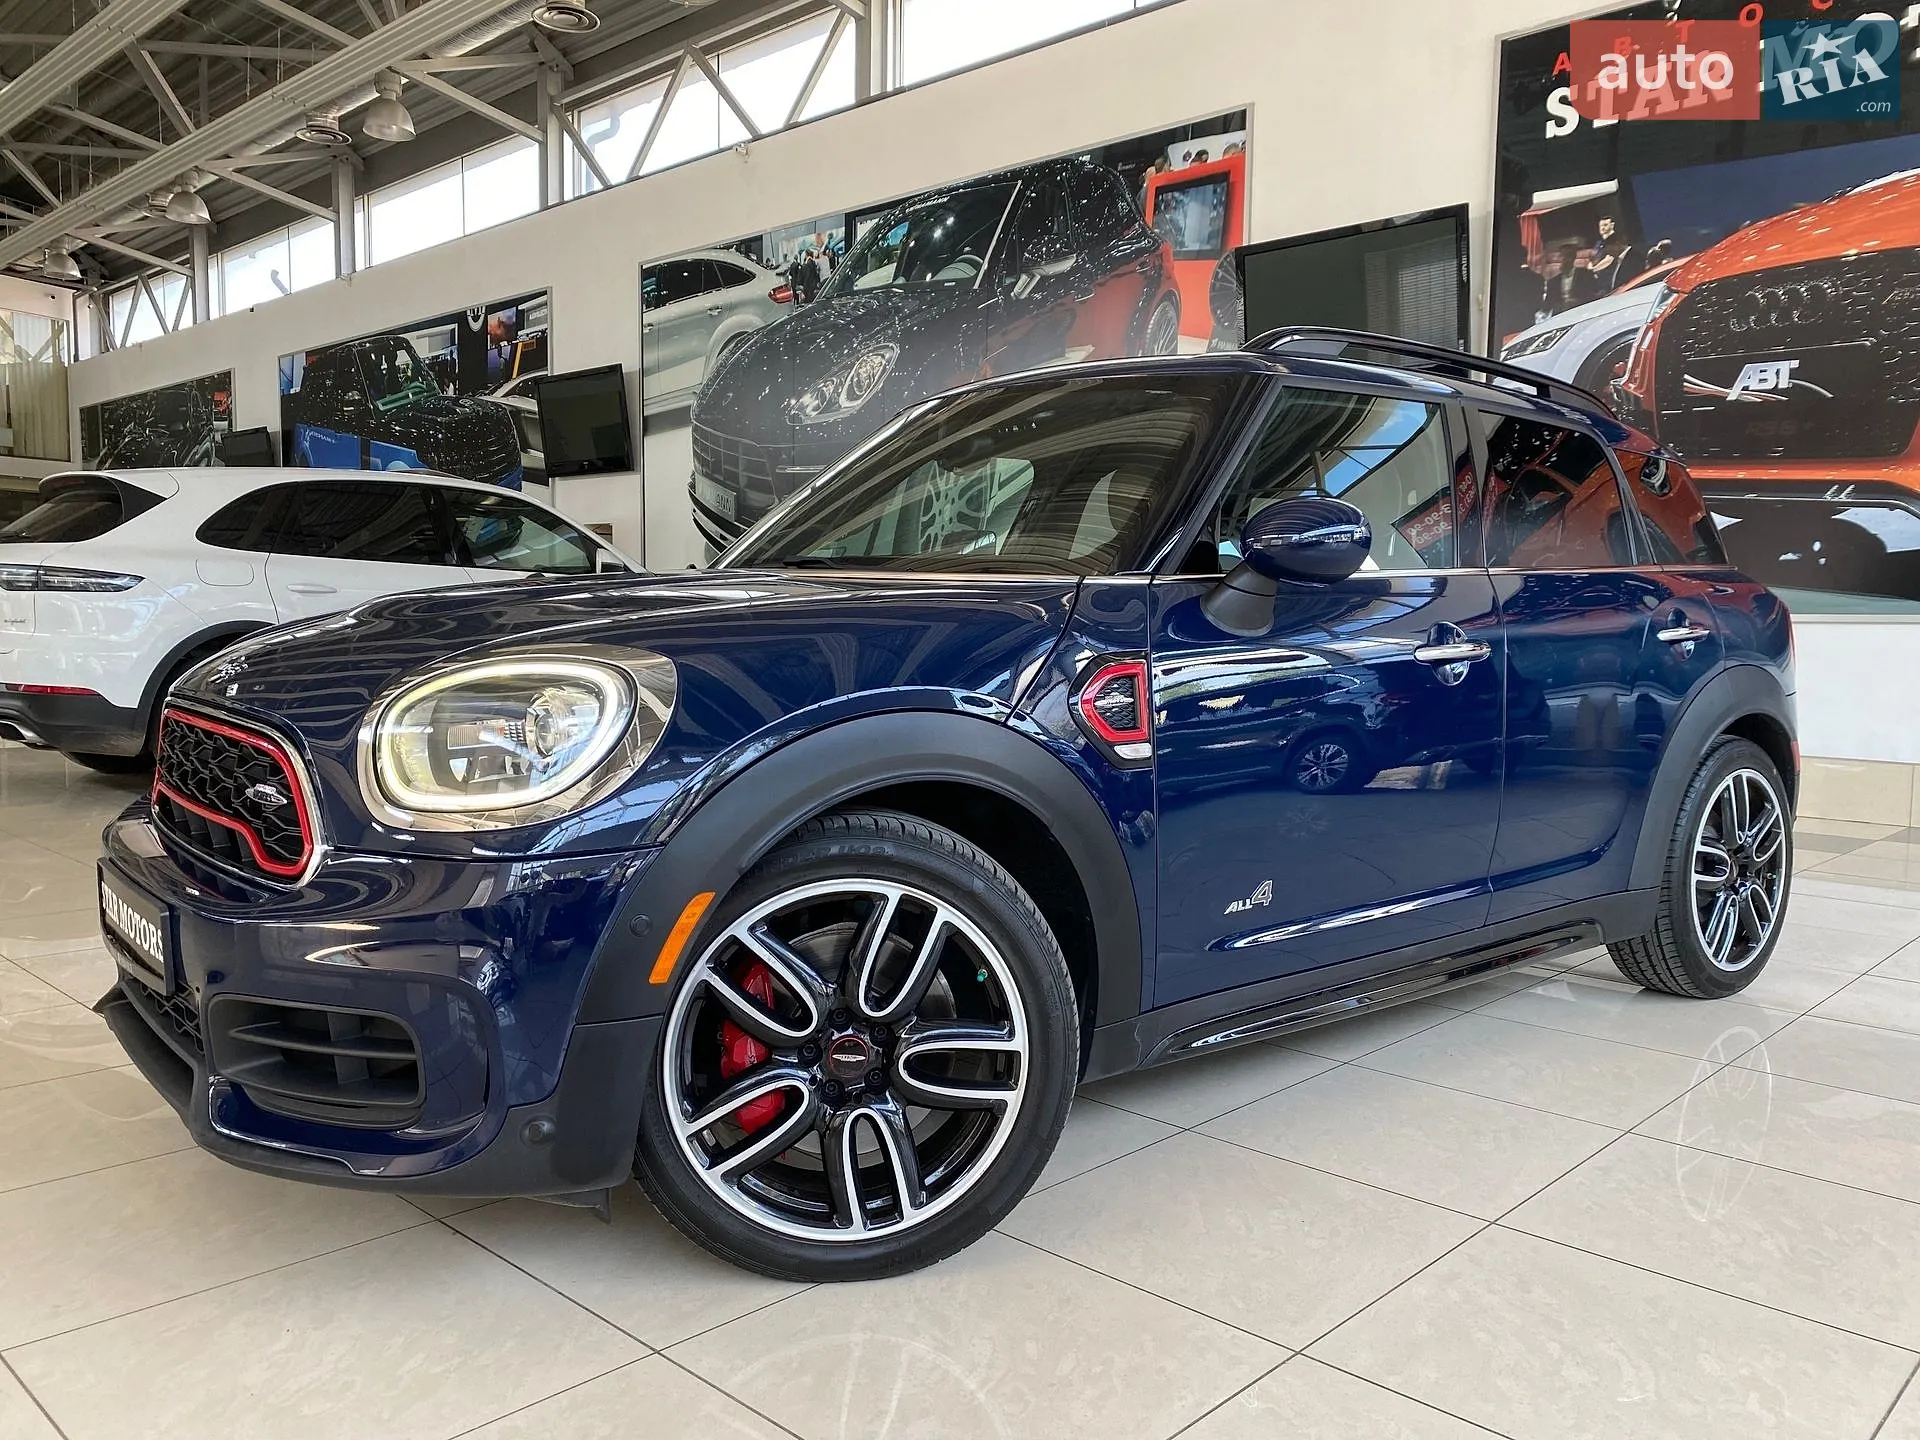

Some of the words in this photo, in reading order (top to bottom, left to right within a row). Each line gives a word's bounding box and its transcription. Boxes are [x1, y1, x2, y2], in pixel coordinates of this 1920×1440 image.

[1726, 359, 1800, 401] ABT
[1223, 879, 1273, 915] ALL4
[101, 880, 119, 925] STAR
[118, 897, 164, 964] MOTORS
